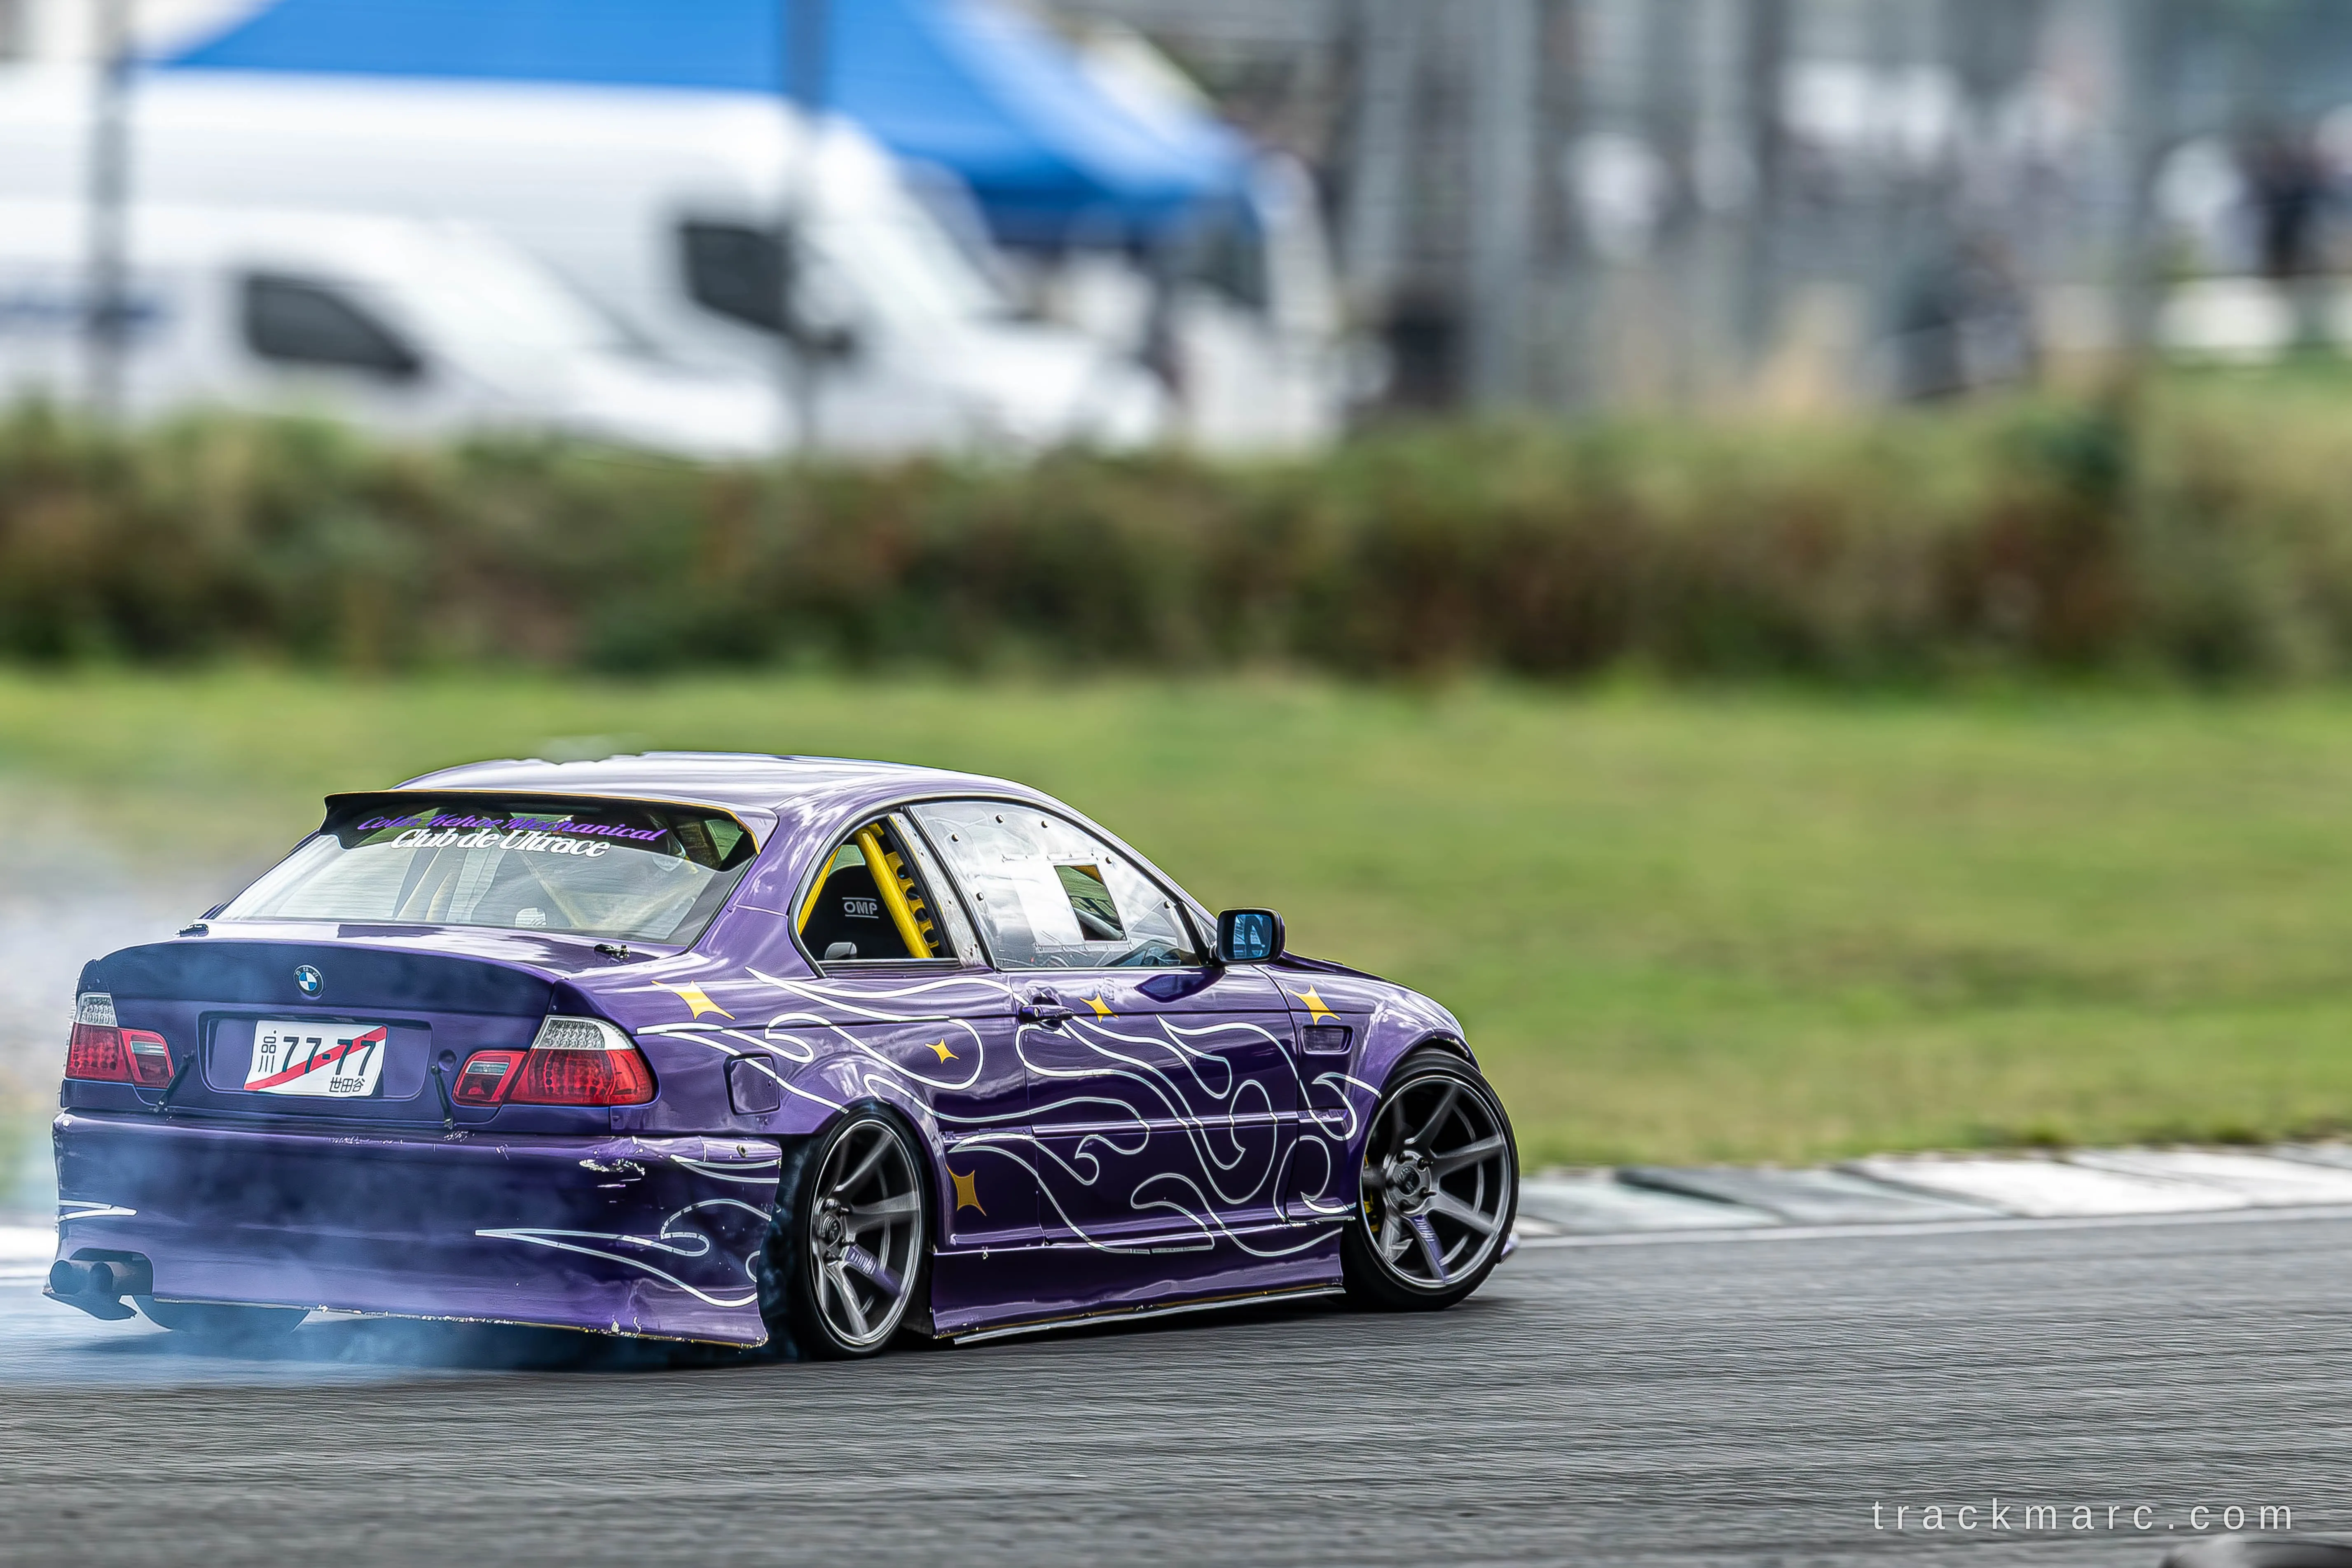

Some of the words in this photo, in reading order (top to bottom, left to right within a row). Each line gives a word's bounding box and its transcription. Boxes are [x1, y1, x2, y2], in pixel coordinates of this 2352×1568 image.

[357, 815, 421, 830] Colin
[426, 814, 504, 828] Kehoe
[501, 817, 668, 840] Mechanical
[391, 827, 459, 849] Club
[456, 828, 501, 849] de
[499, 829, 611, 857] Ultrace
[843, 901, 878, 915] OMP
[258, 1036, 276, 1073] 品川
[282, 1036, 376, 1076] 77-77
[329, 1077, 365, 1093] 世田谷
